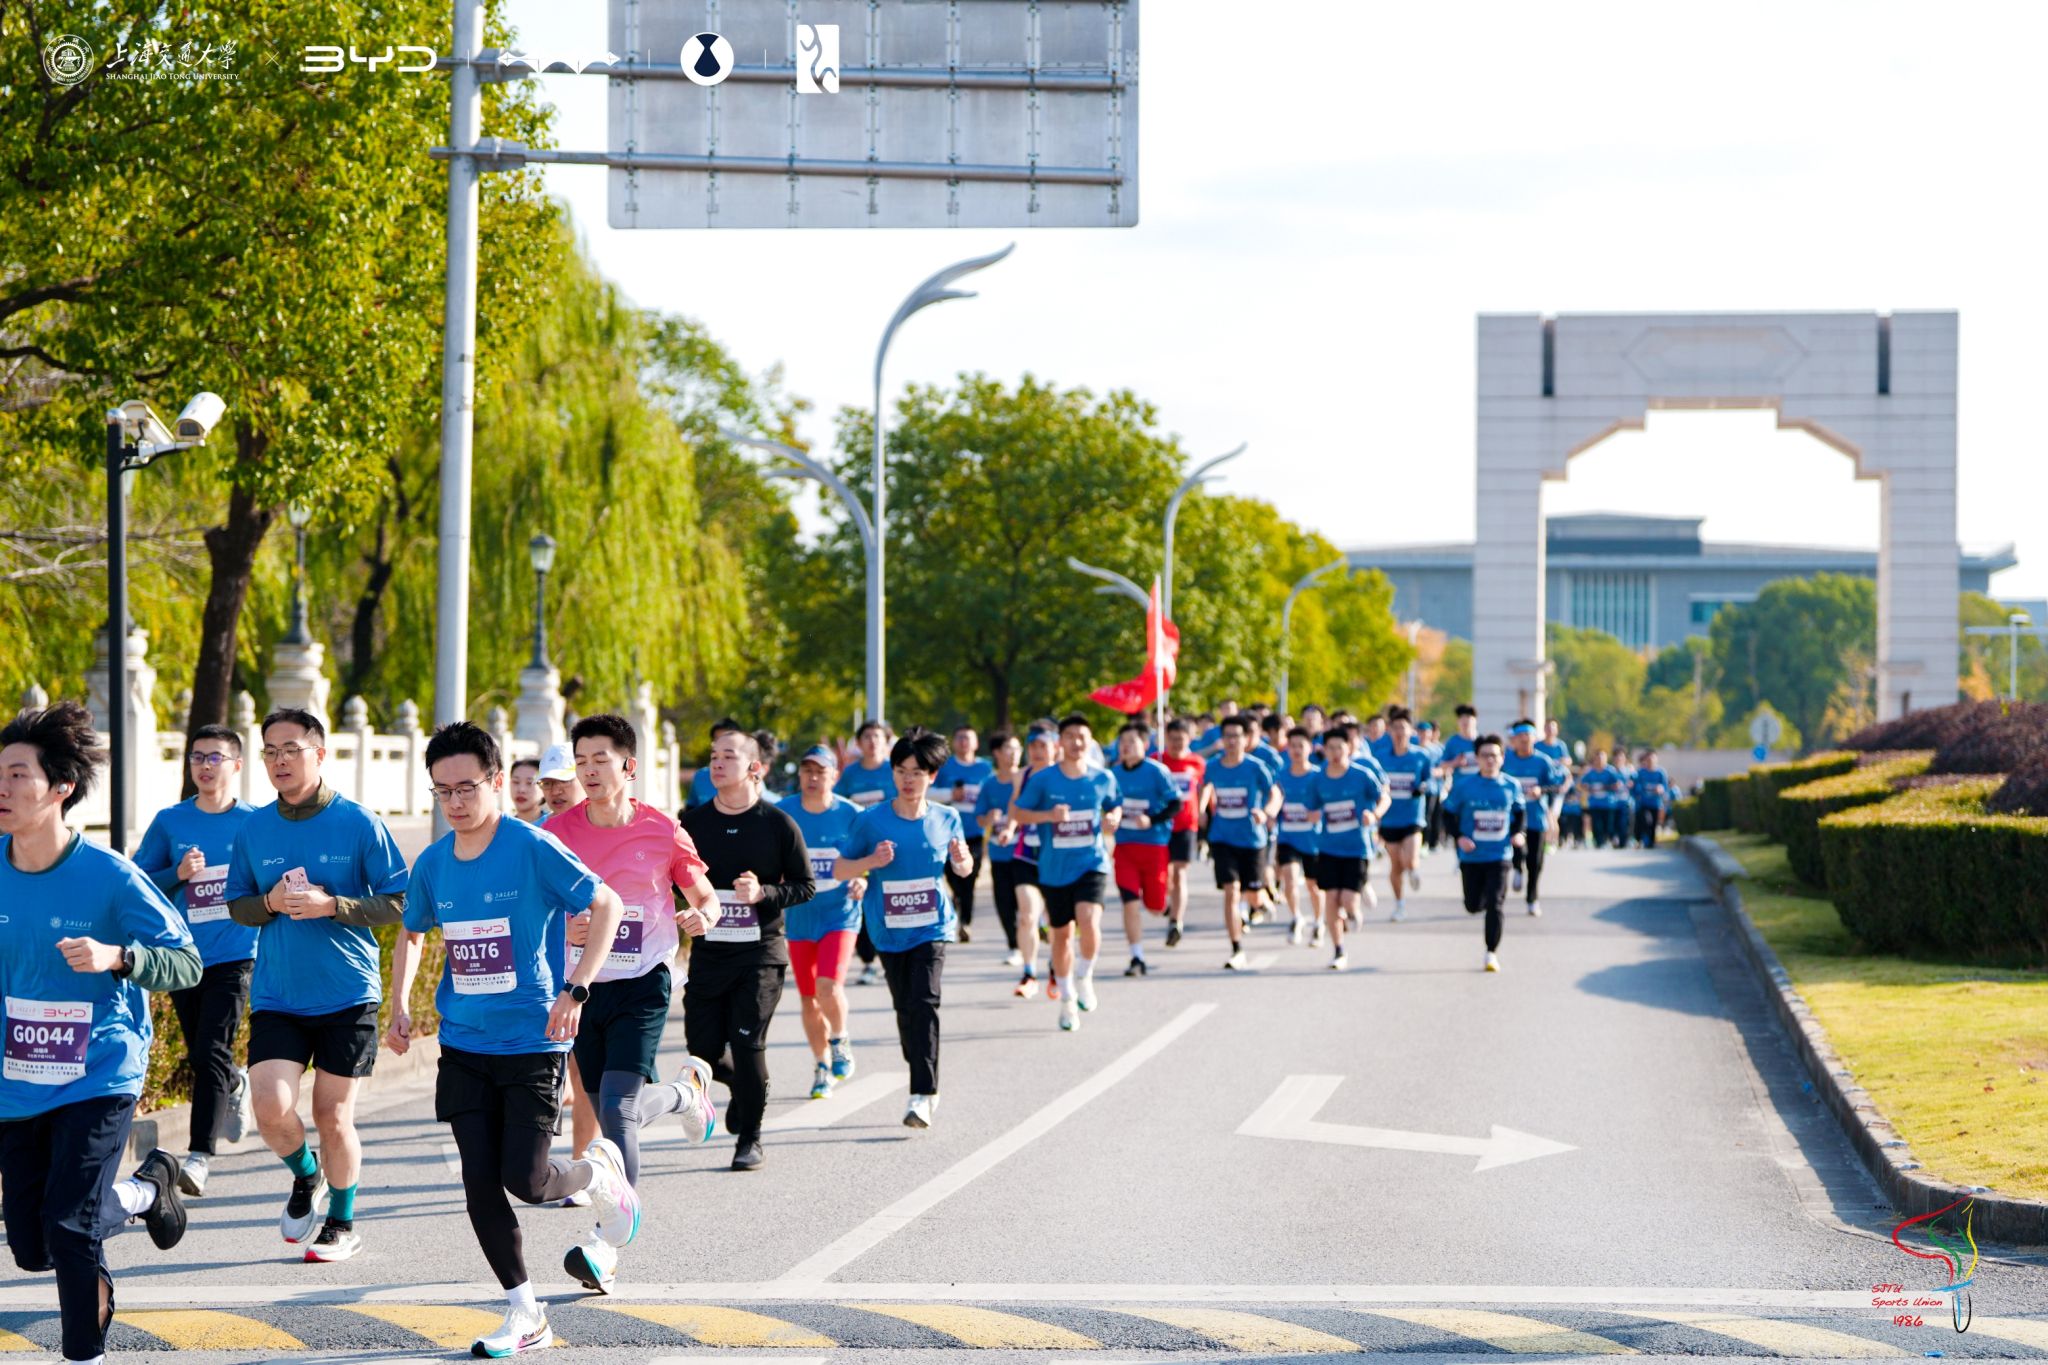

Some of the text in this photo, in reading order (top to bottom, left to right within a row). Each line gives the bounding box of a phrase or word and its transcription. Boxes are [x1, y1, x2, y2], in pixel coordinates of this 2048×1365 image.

[811, 861, 832, 872] 017
[890, 892, 929, 907] G0052
[720, 905, 751, 918] 0123
[472, 924, 505, 936] BYD
[452, 942, 500, 961] G0176
[43, 1008, 87, 1018] BYD
[13, 1024, 75, 1046] G0044
